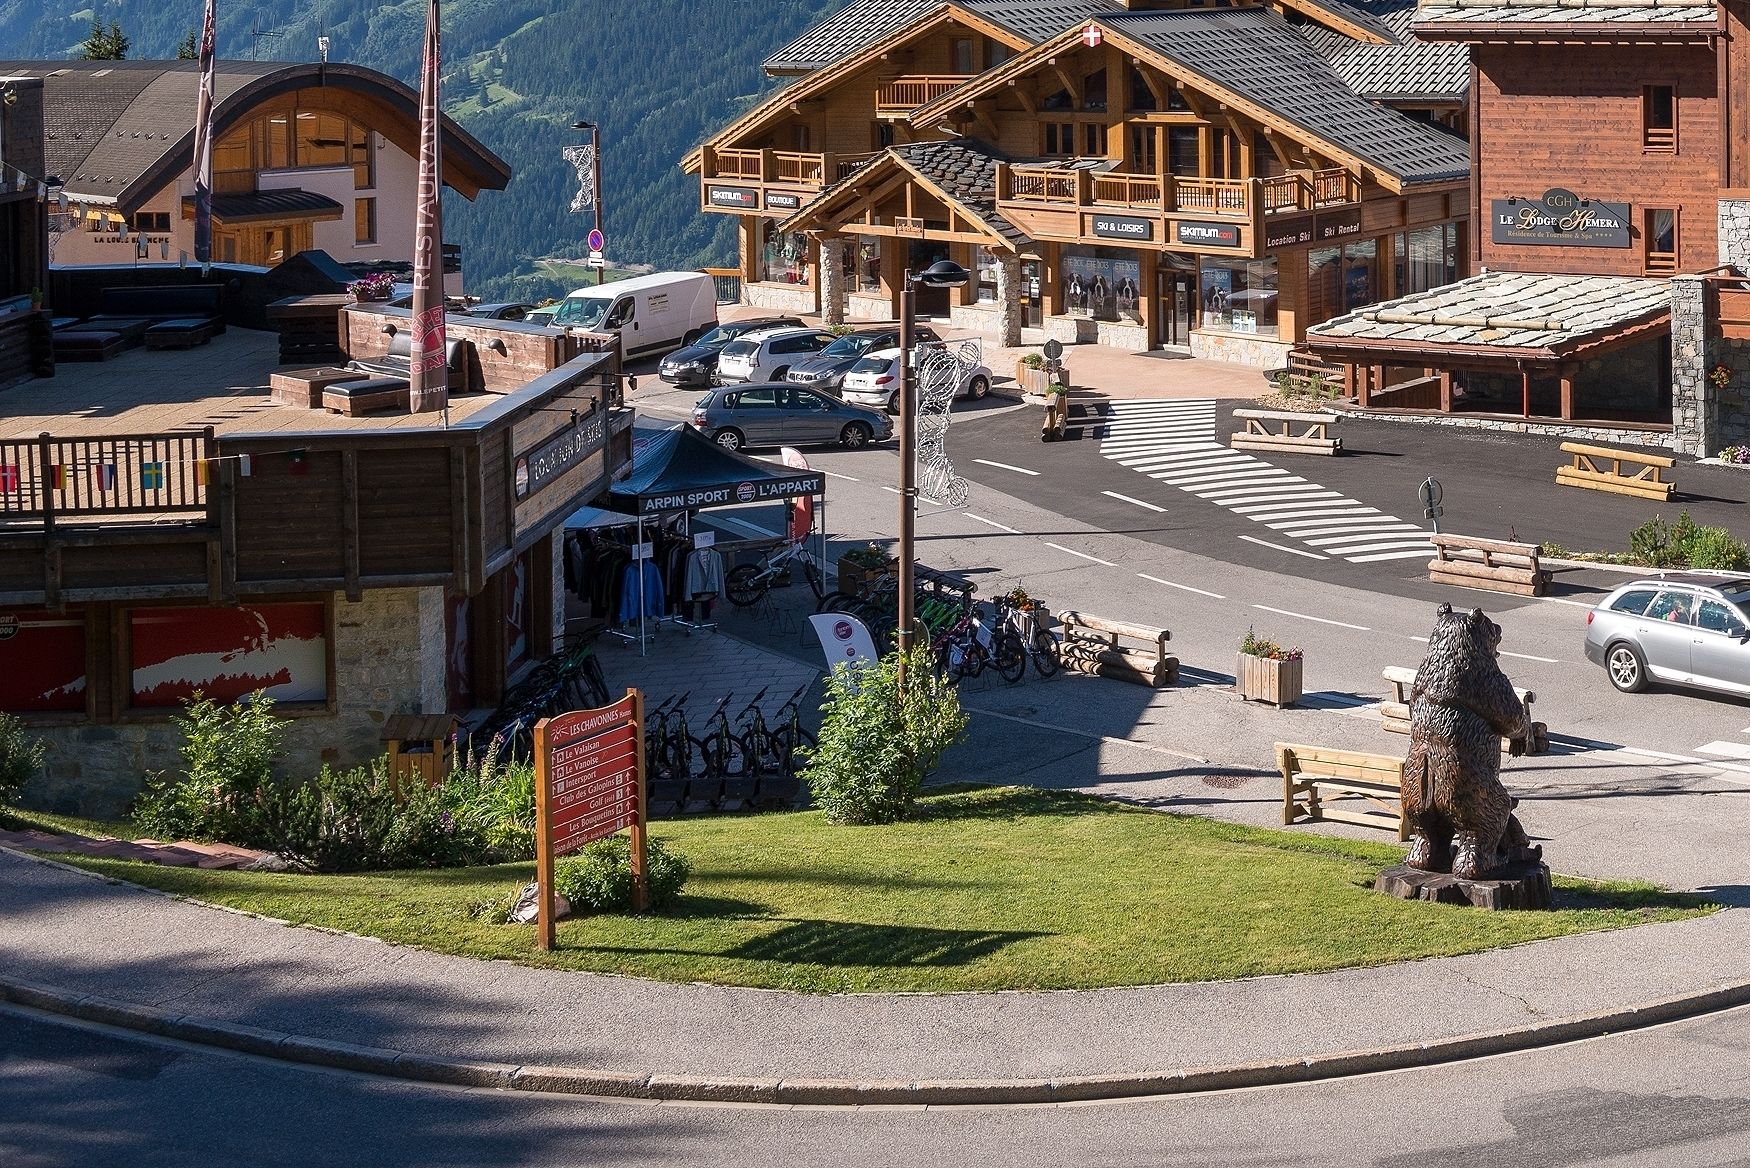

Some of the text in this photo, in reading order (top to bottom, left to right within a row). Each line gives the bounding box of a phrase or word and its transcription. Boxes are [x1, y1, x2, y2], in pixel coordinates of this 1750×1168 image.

[413, 102, 435, 291] RESTAURANT
[767, 195, 794, 205] BOUTIQUE
[1546, 195, 1572, 207] CGH
[1097, 221, 1144, 233] SKI & LOISIRS
[1499, 214, 1514, 225] LE
[1324, 222, 1360, 237] Ski Rental
[1581, 232, 1593, 240] Spa
[94, 236, 104, 244] LA
[107, 236, 129, 244] LOUE
[1267, 231, 1311, 247] Location Ski
[759, 478, 819, 497] L'APPART
[645, 488, 730, 511] ARPIN SPORT
[569, 723, 581, 736] LES
[580, 709, 619, 732] CHAVONNES
[565, 741, 600, 760] Le Valaisan
[565, 756, 599, 774] Le Vanoise
[565, 770, 597, 789] Intersport
[559, 778, 615, 806] Club des Galopins
[589, 797, 604, 809] Golf
[569, 807, 615, 832] Les Bouquetins
[553, 843, 566, 852] aison
